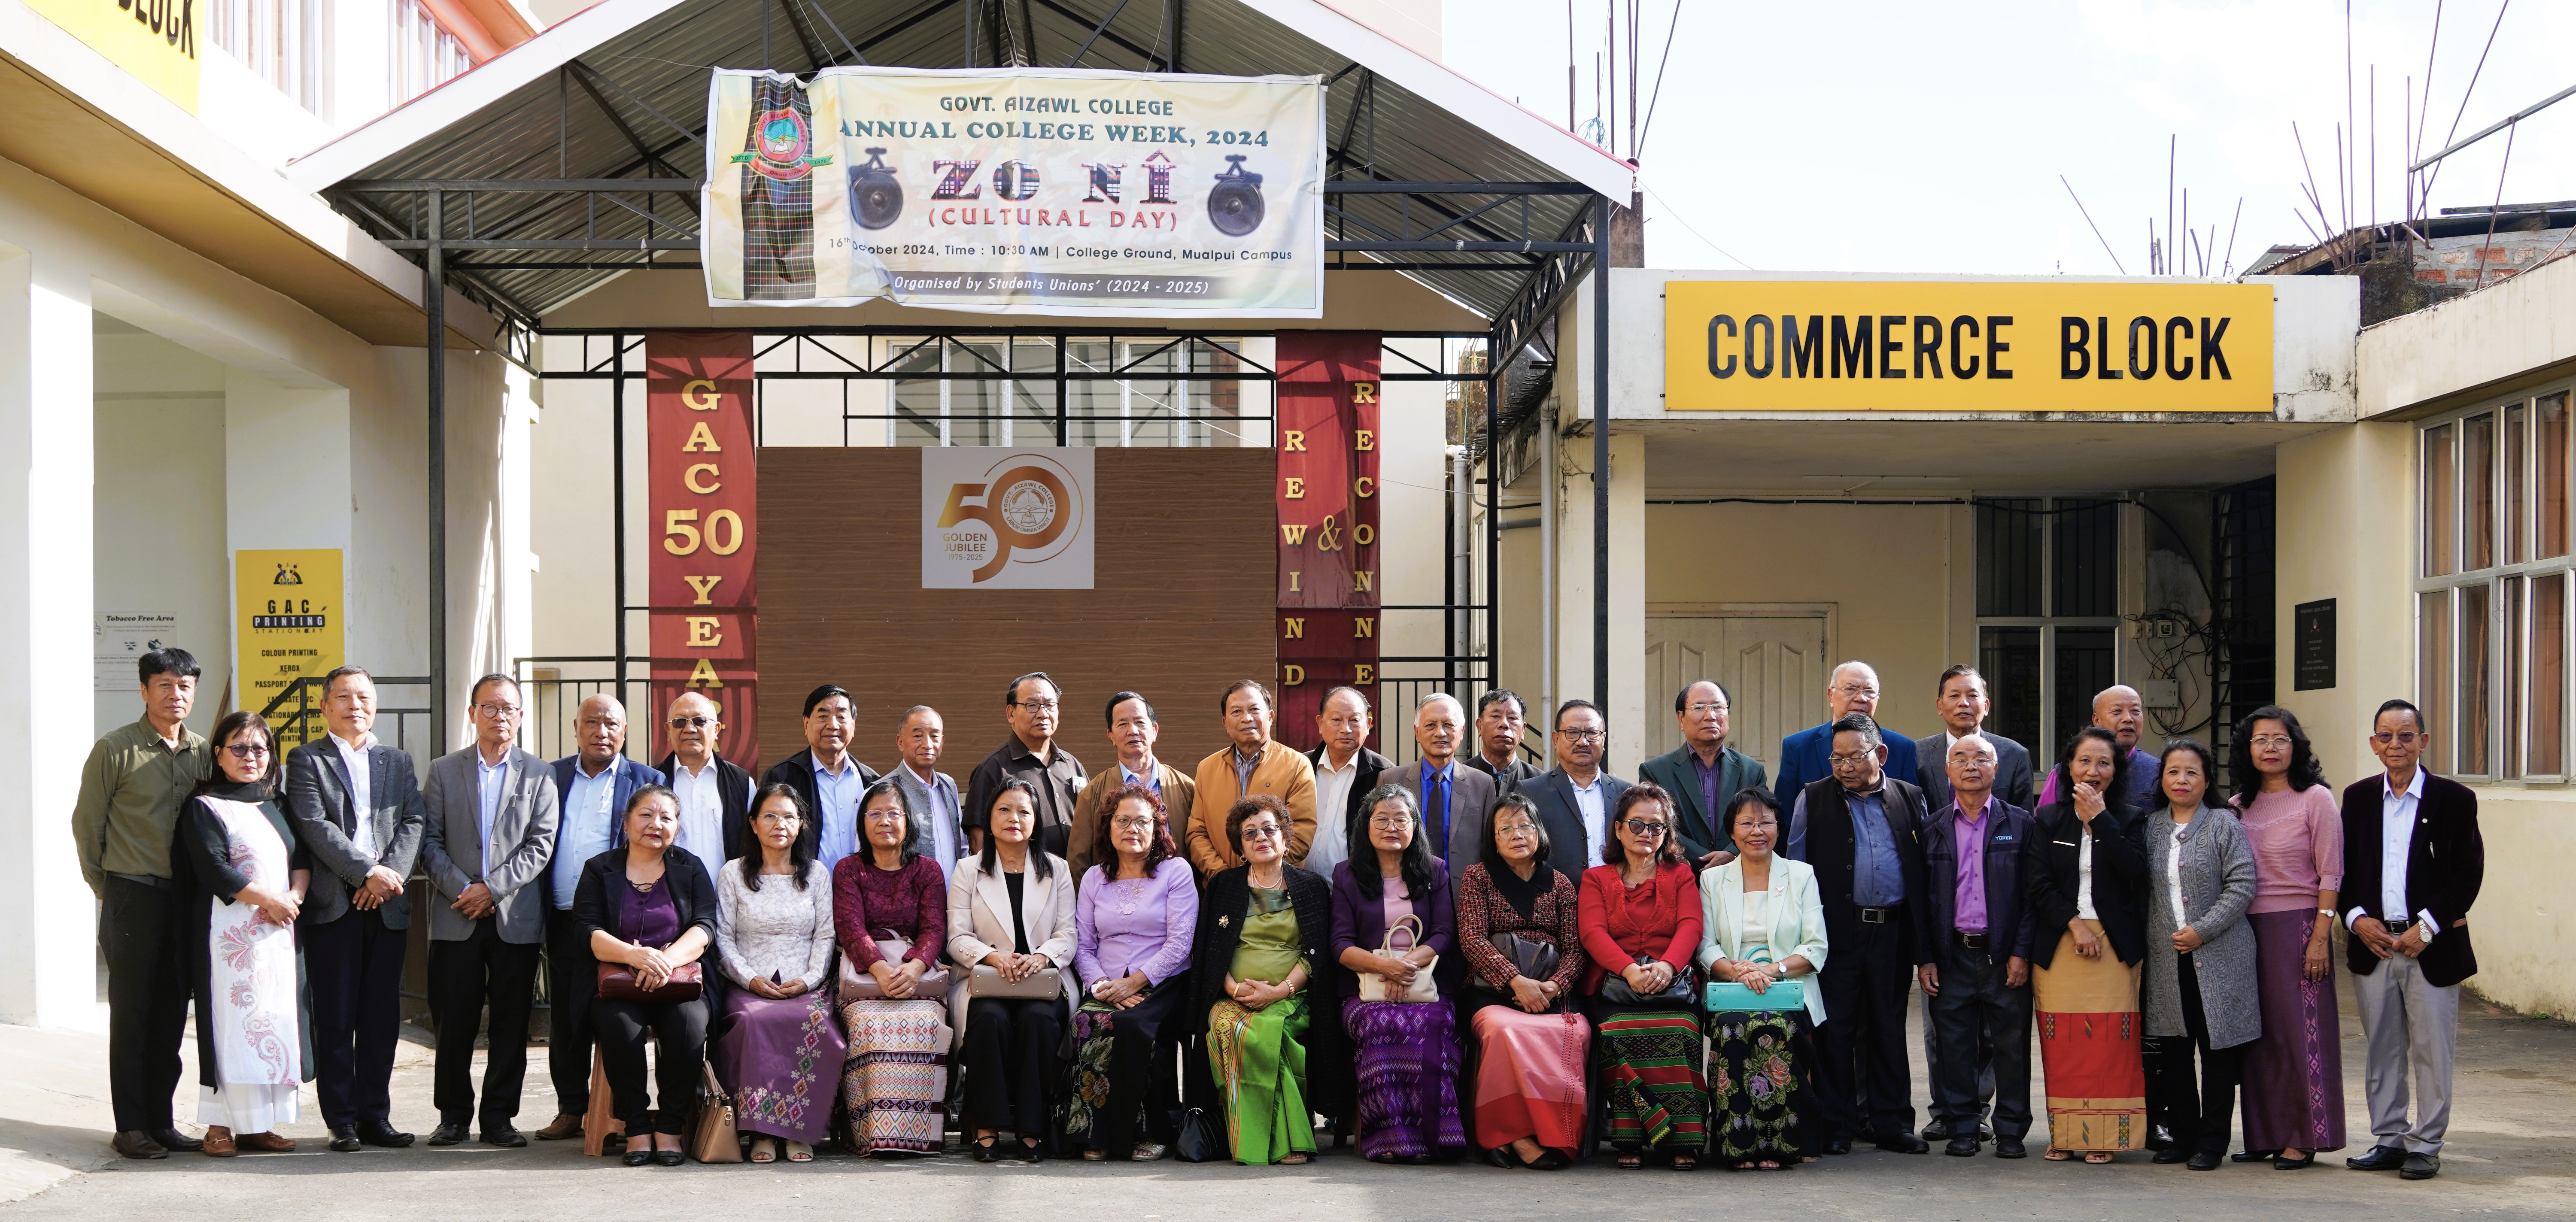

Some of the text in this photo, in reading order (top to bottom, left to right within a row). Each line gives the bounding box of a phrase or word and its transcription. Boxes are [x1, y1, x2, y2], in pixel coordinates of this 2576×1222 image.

[940, 96, 1173, 116] GOVT. AIZAWL COLLEGE
[839, 118, 1269, 147] ANNUAL COLLEGE WEEK, 2024
[930, 158, 1040, 202] ZO
[929, 208, 1177, 231] (CULTURAL DAY)
[903, 245, 939, 256] 2024,
[945, 245, 975, 255] Time
[991, 245, 1025, 255] 10:30
[1030, 246, 1049, 256] AM
[1066, 247, 1118, 260] College
[1124, 248, 1176, 261] Ground,
[1182, 249, 1235, 261] Mualpui
[1240, 250, 1292, 261] Campus
[894, 276, 962, 291] Organised
[966, 276, 982, 291] by
[987, 277, 1044, 290] Students
[1107, 279, 1150, 293] (2024
[1165, 281, 1209, 294] 2025)
[1707, 314, 2233, 381] COMMERCE BLOCK
[1038, 485, 1054, 508] COLLEGE
[1006, 516, 1020, 530] LABOR
[1036, 517, 1051, 531] VINCIT
[943, 533, 987, 541] GOLDEN
[944, 543, 986, 552] JUBILEE
[1282, 382, 1376, 730] REWIND & RECONNE
[663, 379, 744, 752] GAC 50 YEA
[268, 599, 310, 614] GAC
[255, 616, 323, 627] PRINTING
